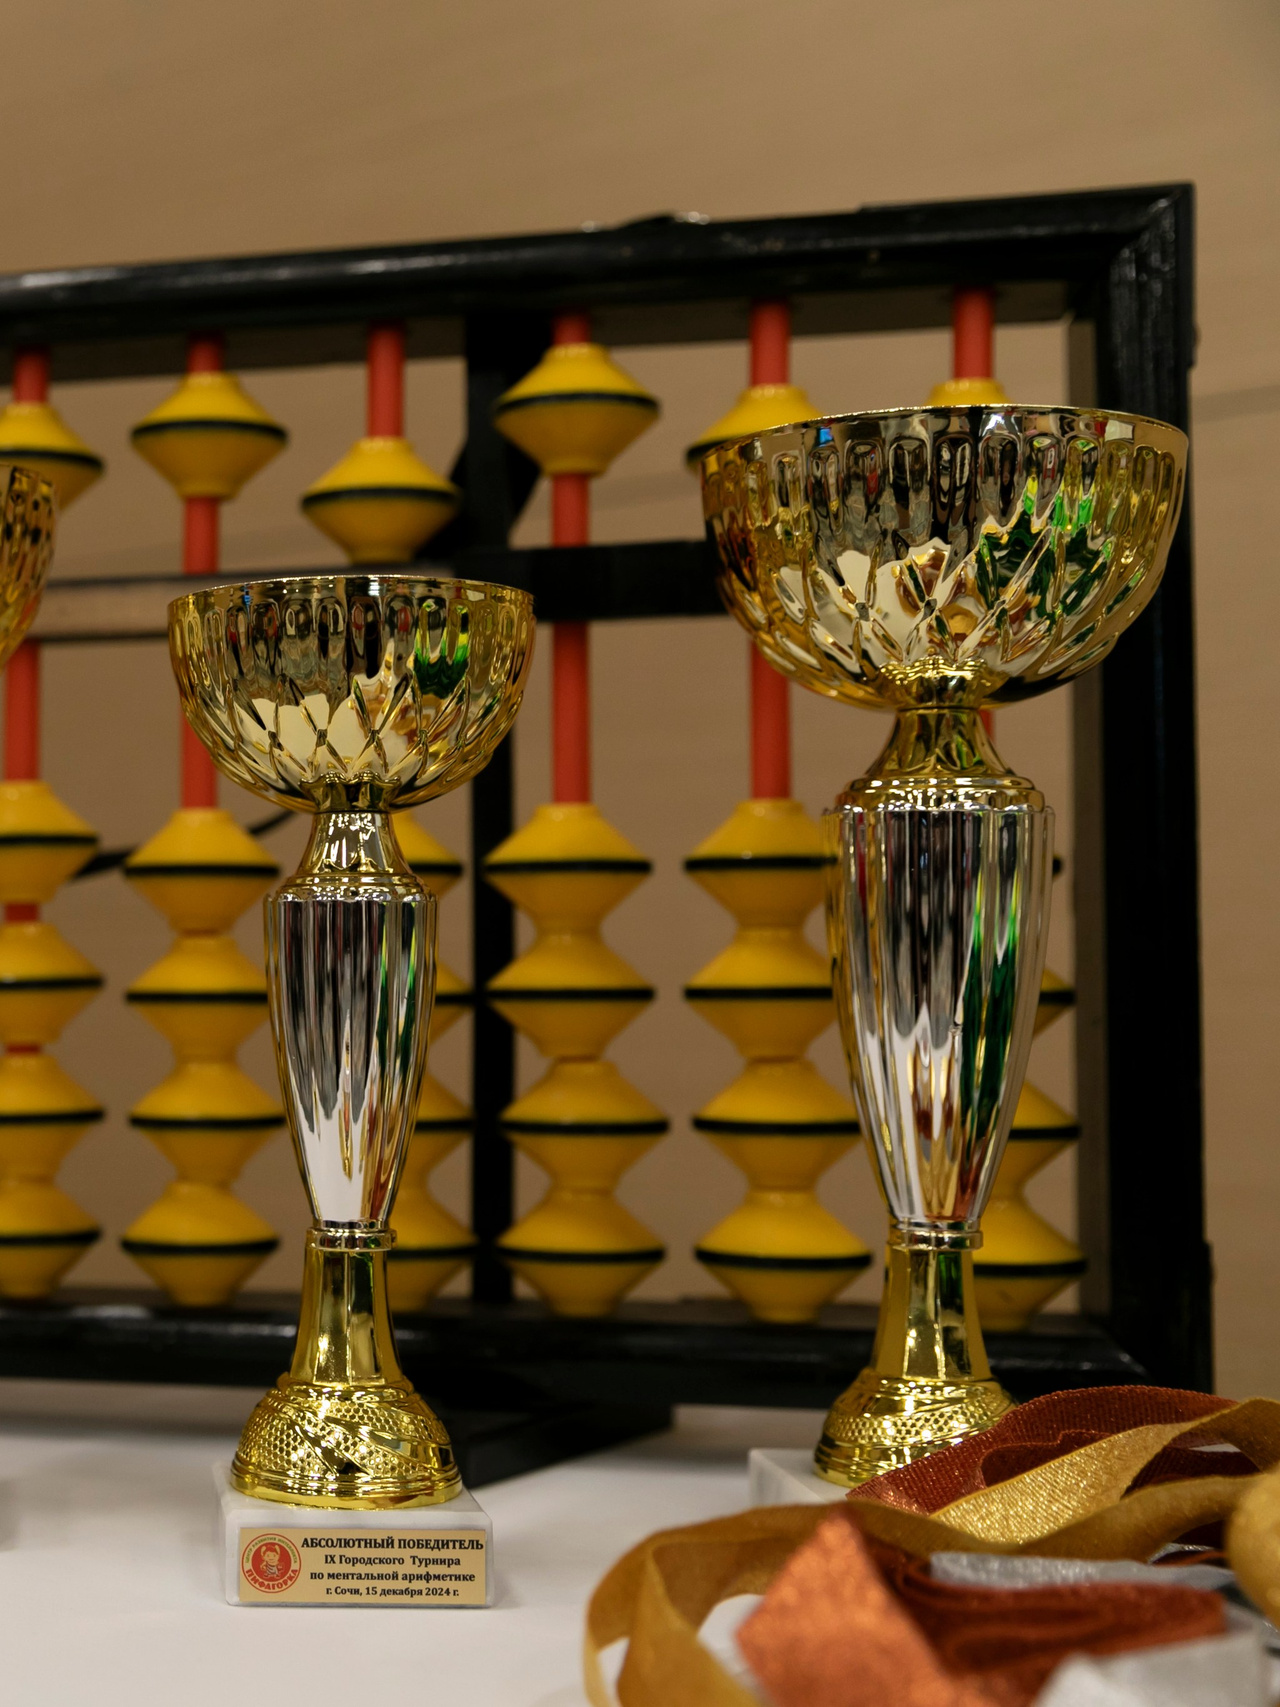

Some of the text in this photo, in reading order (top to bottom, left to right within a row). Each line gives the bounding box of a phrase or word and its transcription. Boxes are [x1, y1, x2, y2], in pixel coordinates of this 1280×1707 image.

[301, 1537, 483, 1551] АБСОЛЮТНЫЙ ПОБЕДИТЕЛЬ
[324, 1555, 460, 1567] IX Городского Турнира
[245, 1568, 298, 1590] ПИФАГОРКА
[327, 1570, 399, 1580] ментальной
[402, 1571, 475, 1583] арифметике
[335, 1586, 362, 1596] Сочи,
[365, 1587, 377, 1595] 15
[380, 1586, 423, 1597] декабря
[425, 1587, 450, 1596] 2024
